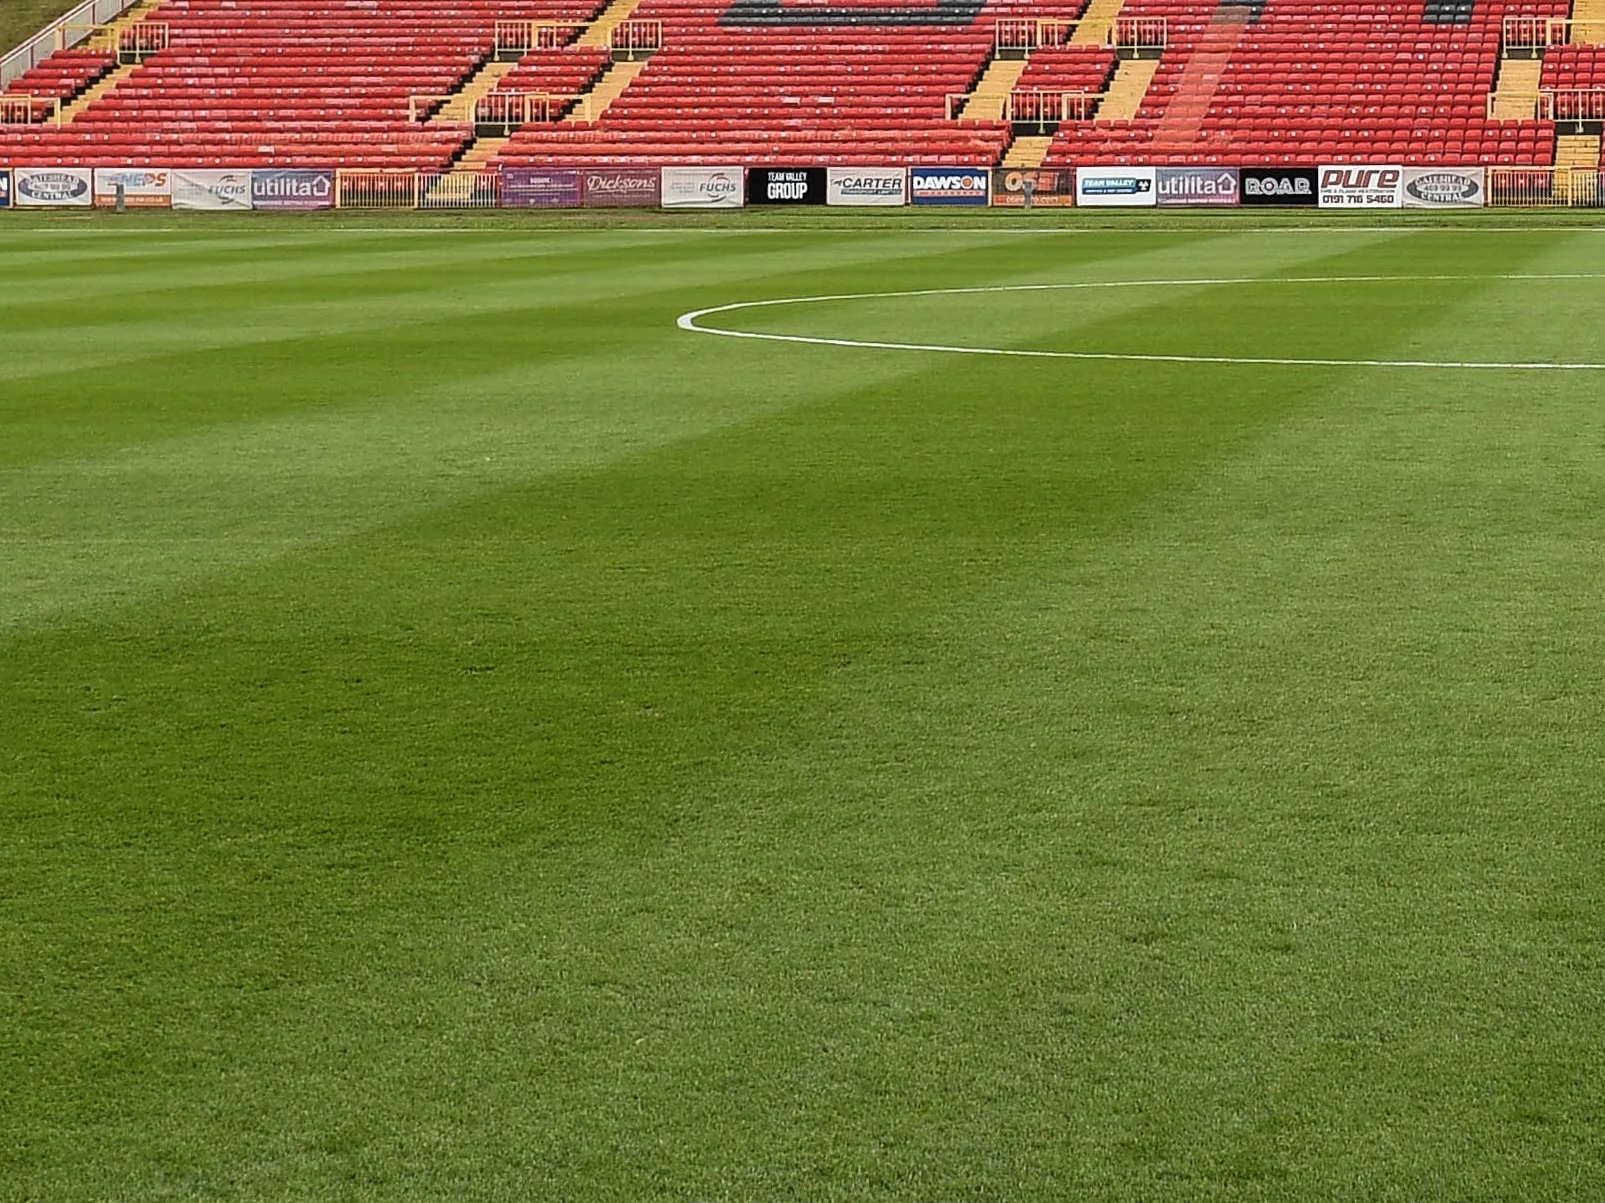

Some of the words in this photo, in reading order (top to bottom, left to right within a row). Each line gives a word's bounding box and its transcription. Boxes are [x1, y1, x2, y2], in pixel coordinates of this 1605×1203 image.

[767, 172, 785, 181] TEAM
[786, 172, 808, 181] VALLEY
[1414, 174, 1471, 185] GATESHEAD
[253, 177, 312, 196] utilita
[587, 174, 657, 191] Dicksons
[699, 183, 736, 193] FUCHS
[842, 177, 903, 188] CARTER
[912, 176, 986, 190] DAWSON
[1084, 179, 1105, 187] TEAM
[1106, 179, 1134, 187] VALLEY
[1158, 176, 1217, 194] utilita
[1245, 177, 1312, 195] ROAR
[767, 182, 808, 199] GROUP
[1322, 194, 1344, 203] 0191
[1346, 194, 1363, 203] 716
[1366, 194, 1394, 203] 5460
[1420, 192, 1464, 203] CENTRAL
